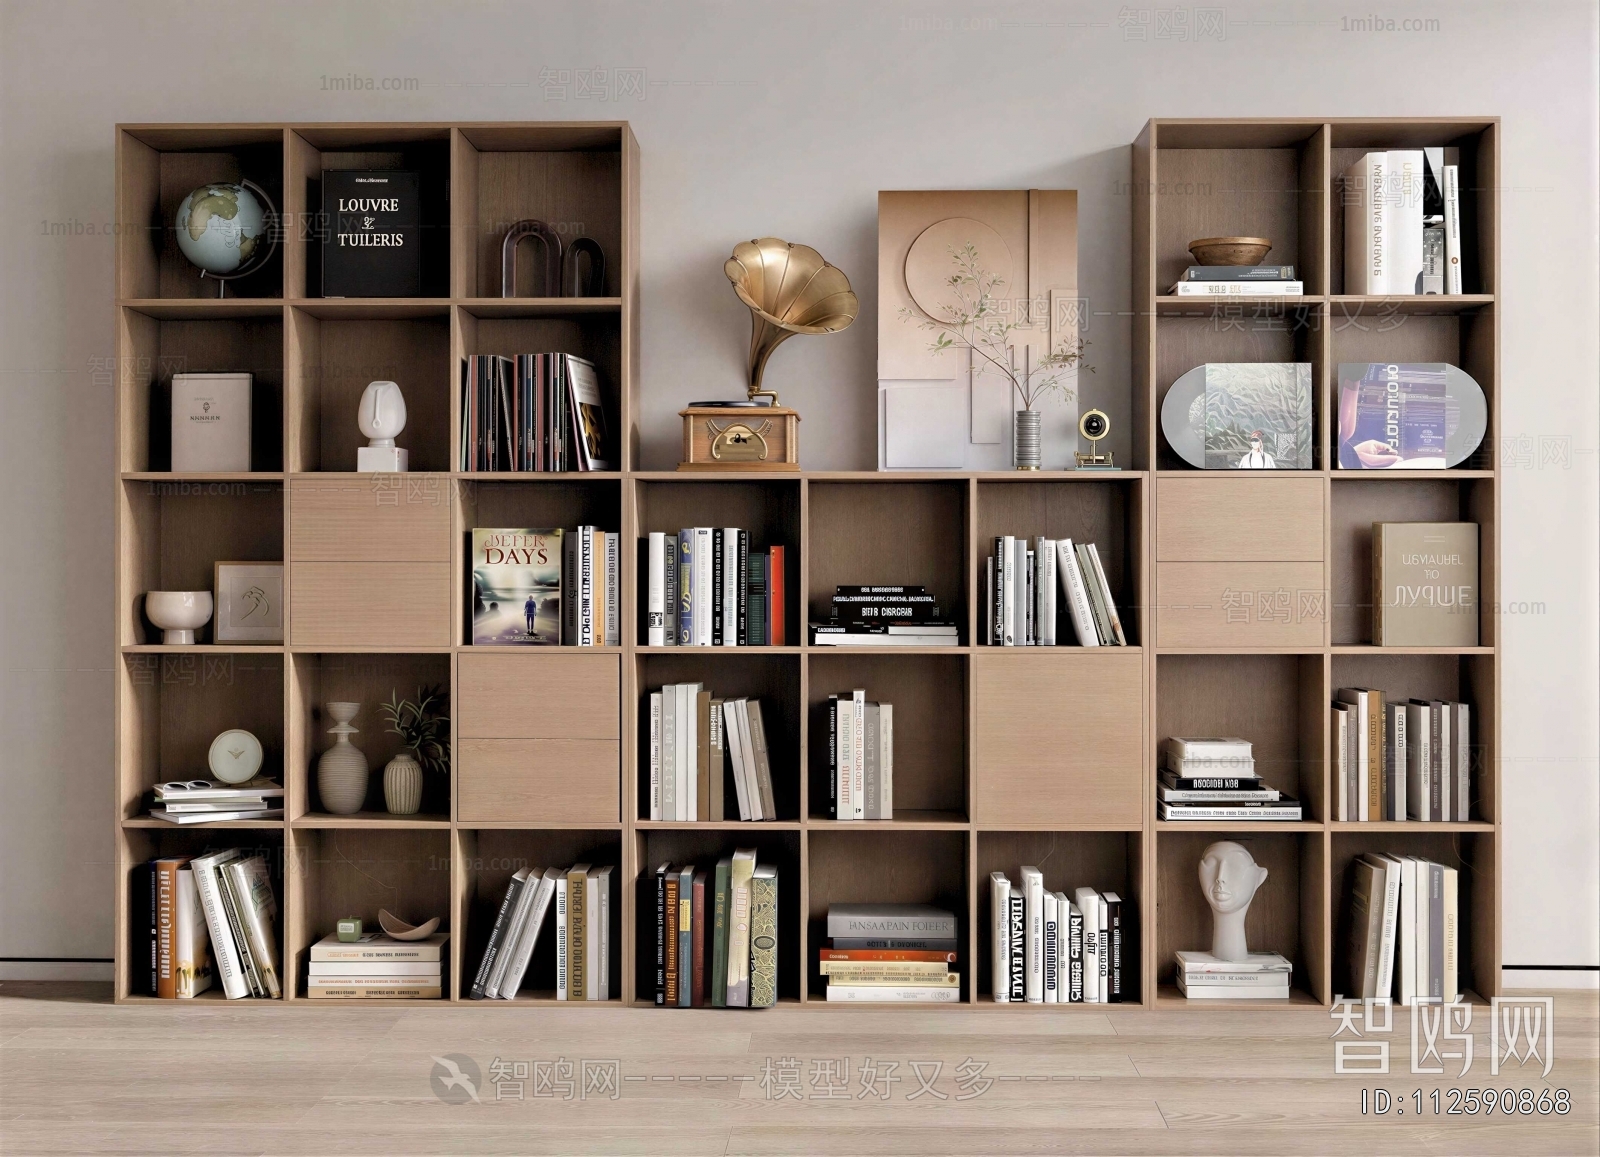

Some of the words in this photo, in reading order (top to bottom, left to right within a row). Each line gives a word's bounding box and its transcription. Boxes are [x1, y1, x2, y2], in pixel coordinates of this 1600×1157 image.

[339, 199, 399, 212] LOUVRE
[338, 234, 404, 247] TUILERIS
[485, 548, 548, 565] DAYS
